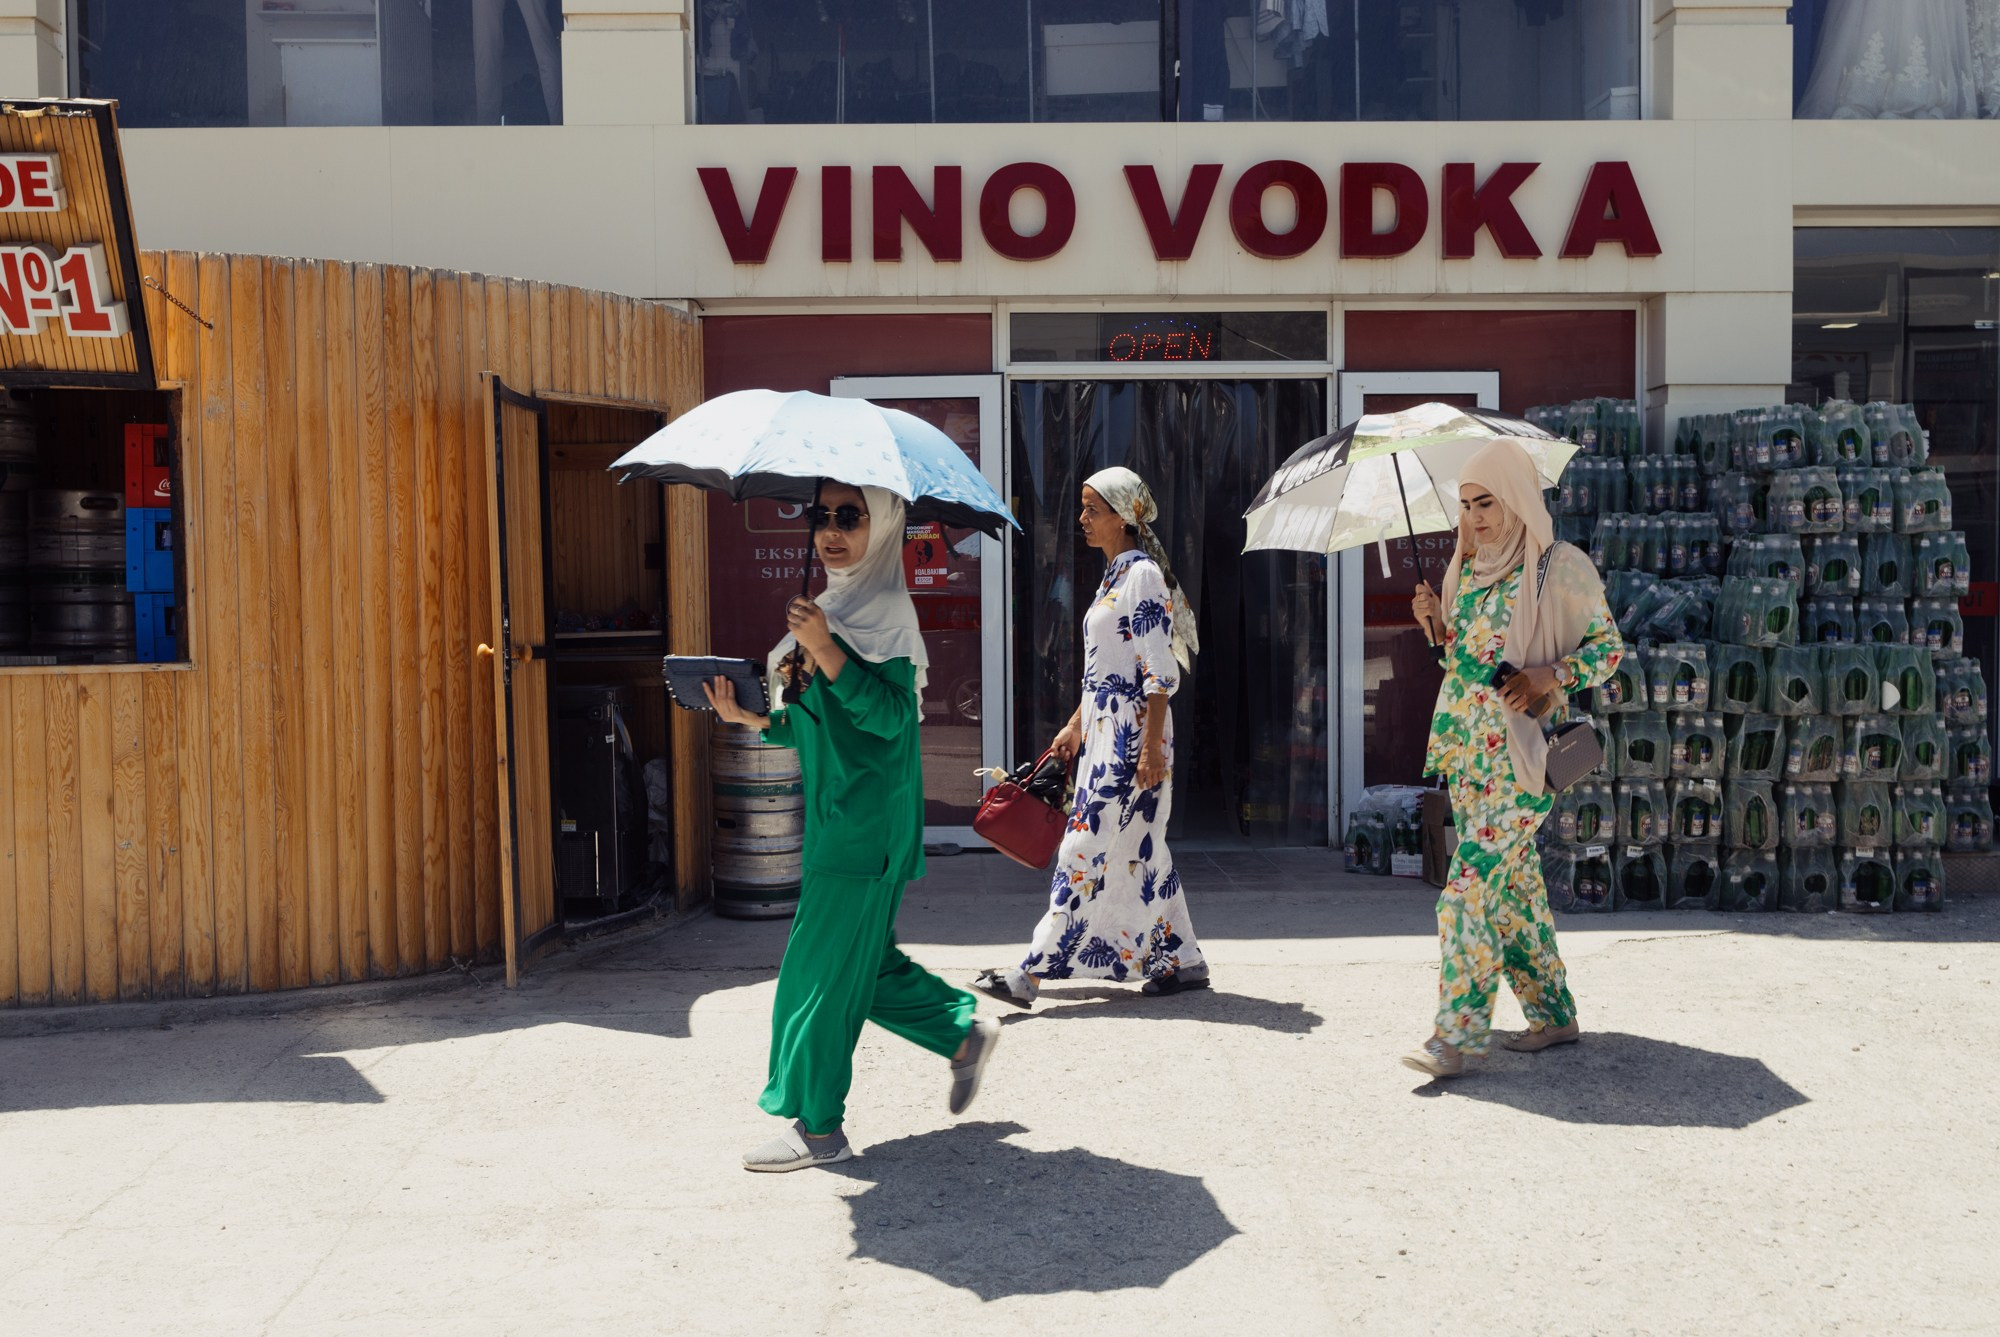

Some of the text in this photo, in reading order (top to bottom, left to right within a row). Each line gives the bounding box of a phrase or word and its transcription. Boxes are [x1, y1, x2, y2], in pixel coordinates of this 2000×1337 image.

[696, 160, 1662, 264] VINO VODKA
[1109, 331, 1212, 361] OPEN
